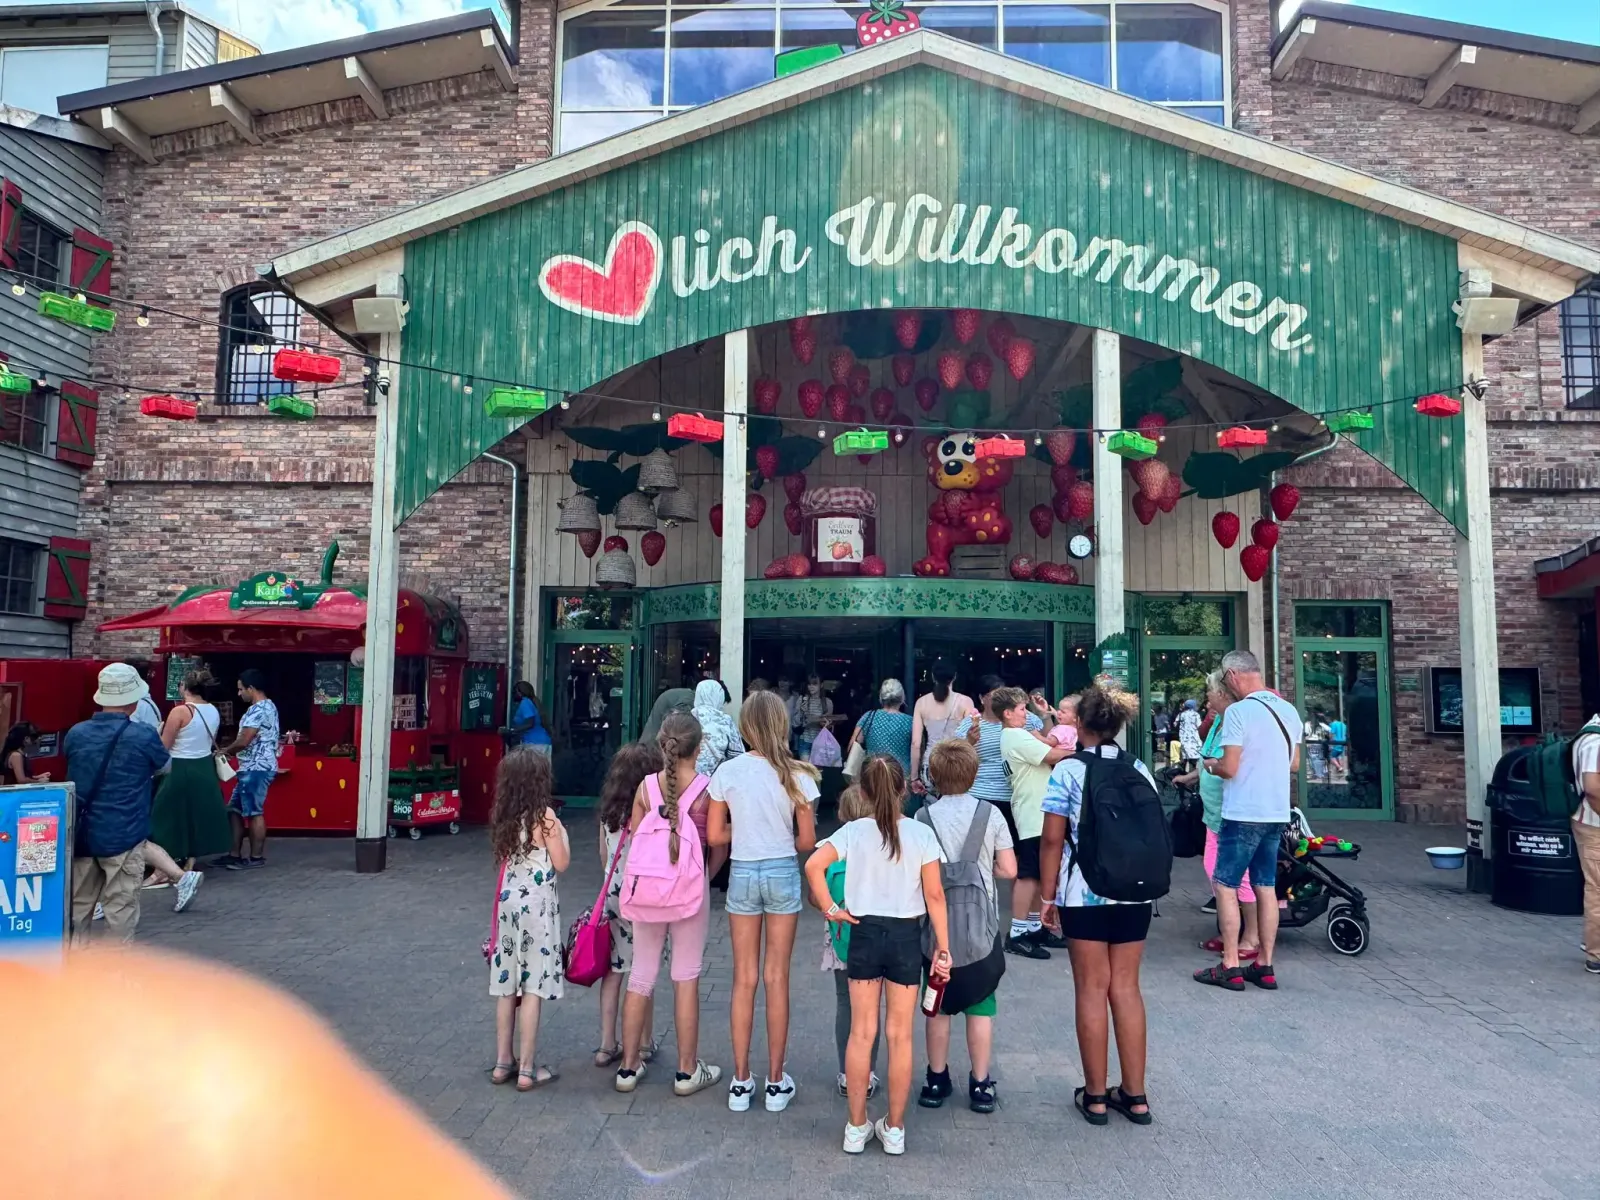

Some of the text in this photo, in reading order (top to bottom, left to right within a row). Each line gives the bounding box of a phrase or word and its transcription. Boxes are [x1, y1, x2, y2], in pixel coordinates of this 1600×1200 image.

[671, 193, 1311, 350] lich Willkommen
[256, 585, 286, 596] Karls
[393, 805, 413, 814] SHOP
[7, 915, 33, 933] Tag
